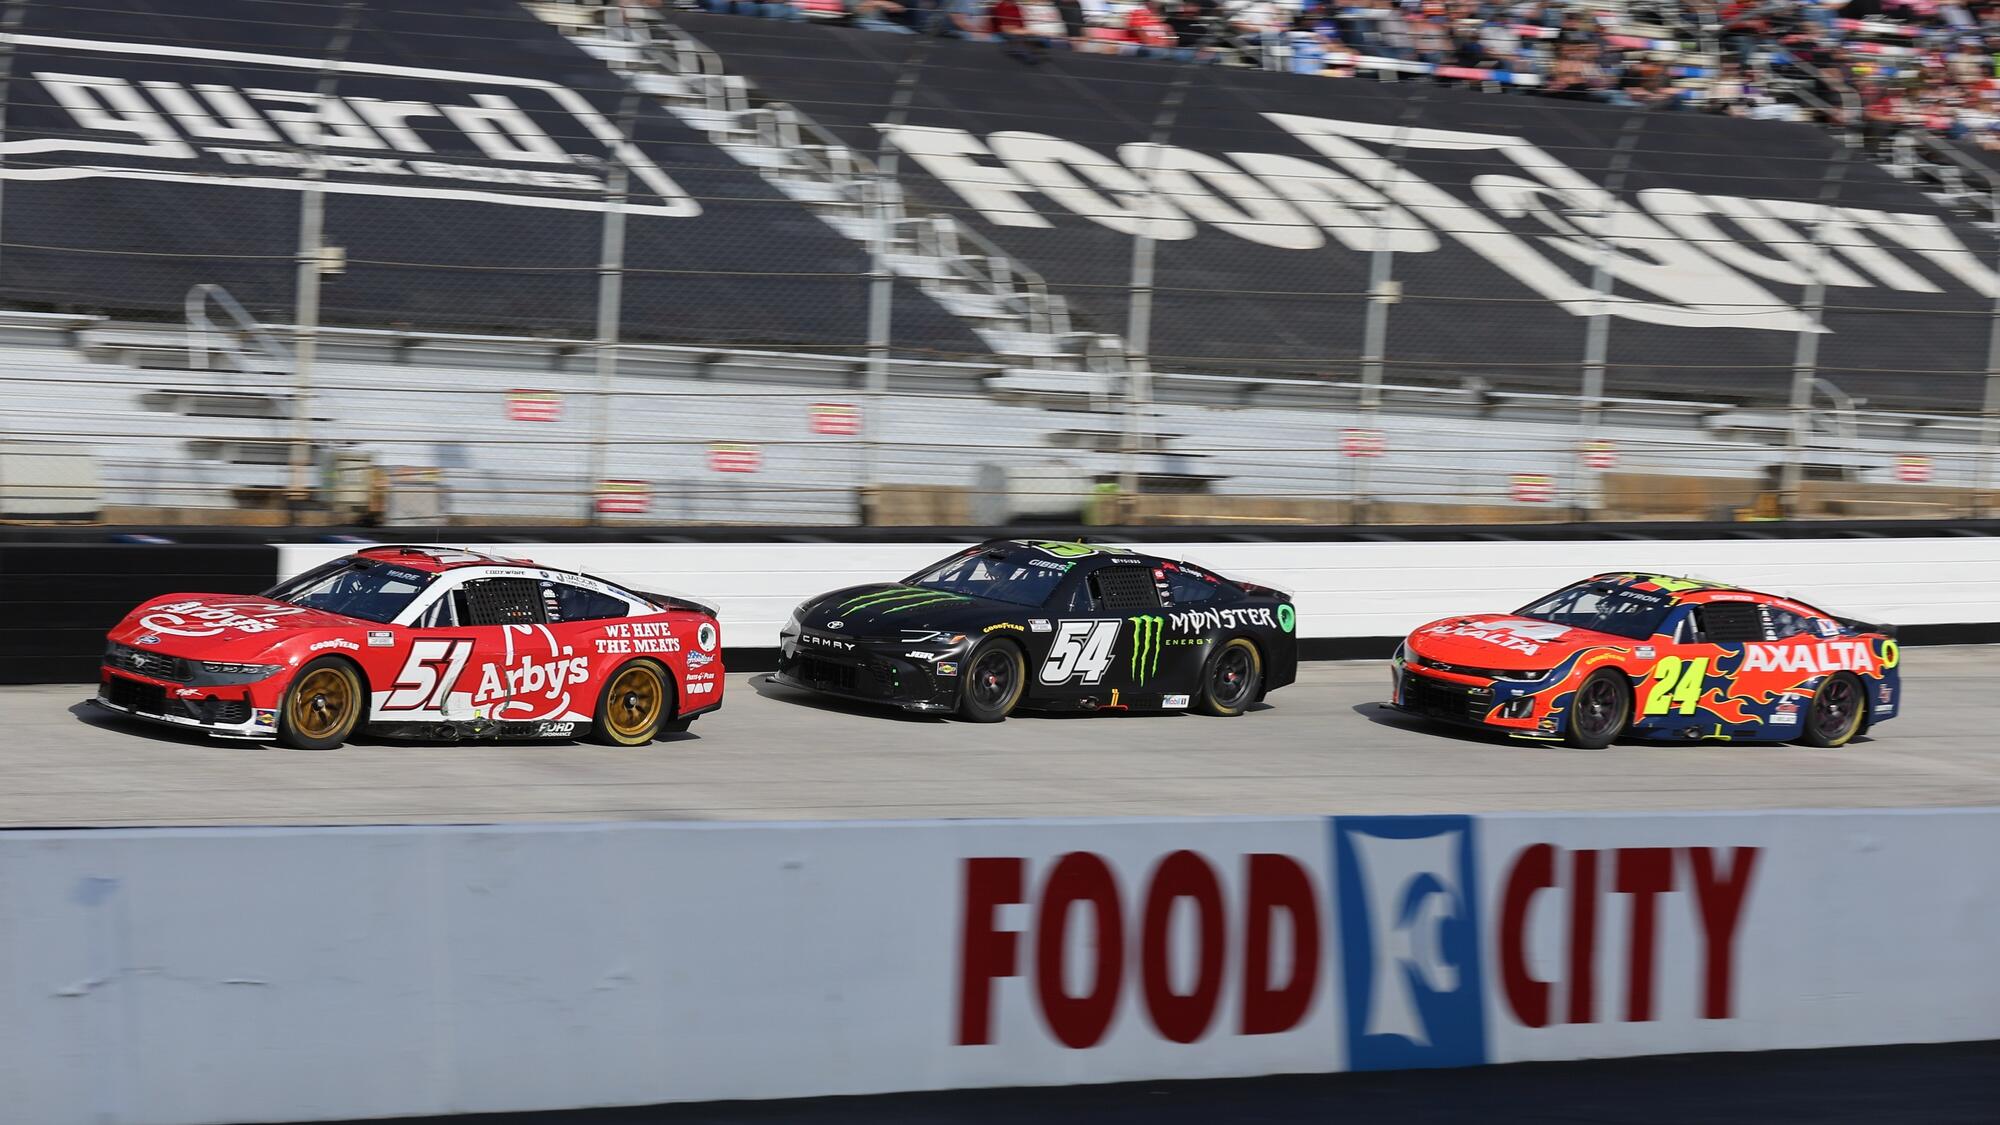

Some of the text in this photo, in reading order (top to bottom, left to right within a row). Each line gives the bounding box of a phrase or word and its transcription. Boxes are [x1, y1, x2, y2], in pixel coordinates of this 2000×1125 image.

[31, 72, 576, 164] guard
[870, 122, 1441, 253] FOOD
[1029, 559, 1067, 571] GIBBS
[386, 569, 420, 581] WARE
[1619, 591, 1662, 603] BYRON
[983, 622, 1025, 633] GOODYEAR
[1169, 607, 1277, 635] MONSTER
[605, 622, 671, 638] WE HAVE
[310, 637, 360, 651] GOODYEAR
[595, 637, 680, 653] THE MEATS
[803, 635, 855, 651] CAMRY
[1165, 638, 1213, 646] ENERGY
[1420, 624, 1540, 656] AXALTA
[905, 651, 934, 660] JGR
[1039, 618, 1123, 686] 54
[1742, 641, 1874, 673] AXALTA
[381, 638, 477, 711] 51
[474, 645, 590, 702] Arby's
[1643, 655, 1709, 715] 24
[539, 722, 575, 732] FORD
[952, 849, 1325, 1049] FOOD
[1496, 842, 1766, 1029] CITY
